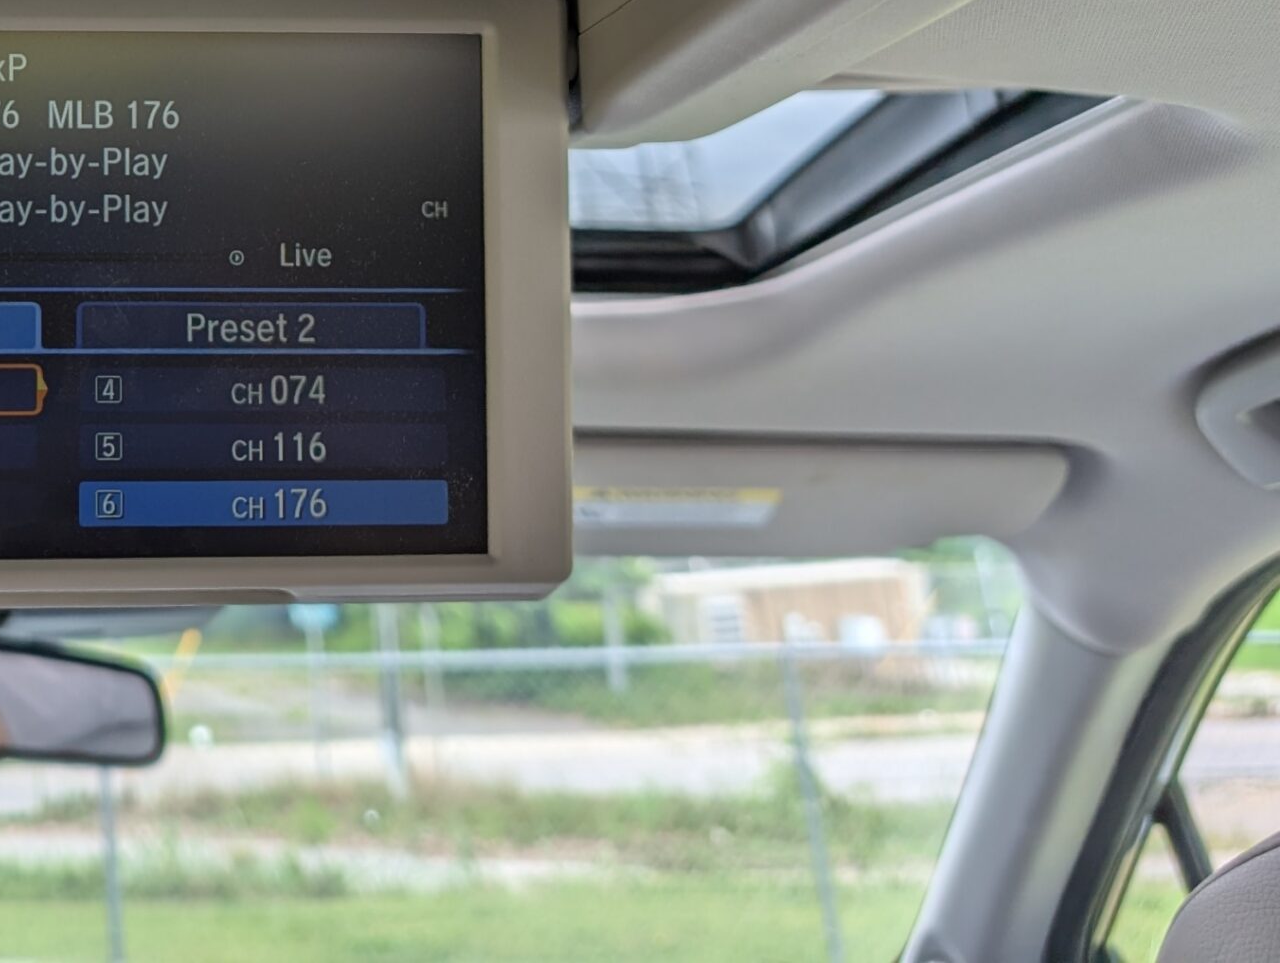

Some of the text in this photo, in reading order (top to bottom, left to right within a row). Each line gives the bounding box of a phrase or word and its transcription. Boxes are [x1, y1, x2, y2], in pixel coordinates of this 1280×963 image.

[48, 100, 114, 129] MLB
[128, 100, 180, 129] 176
[421, 201, 448, 218] CH
[280, 243, 333, 267] Live
[186, 313, 316, 342] Preset 2
[102, 378, 115, 400] 4
[231, 375, 326, 405] CH 074
[102, 436, 115, 457] 5
[231, 432, 327, 462] CH 116
[102, 493, 115, 515] 6
[231, 489, 327, 519] CH 176
